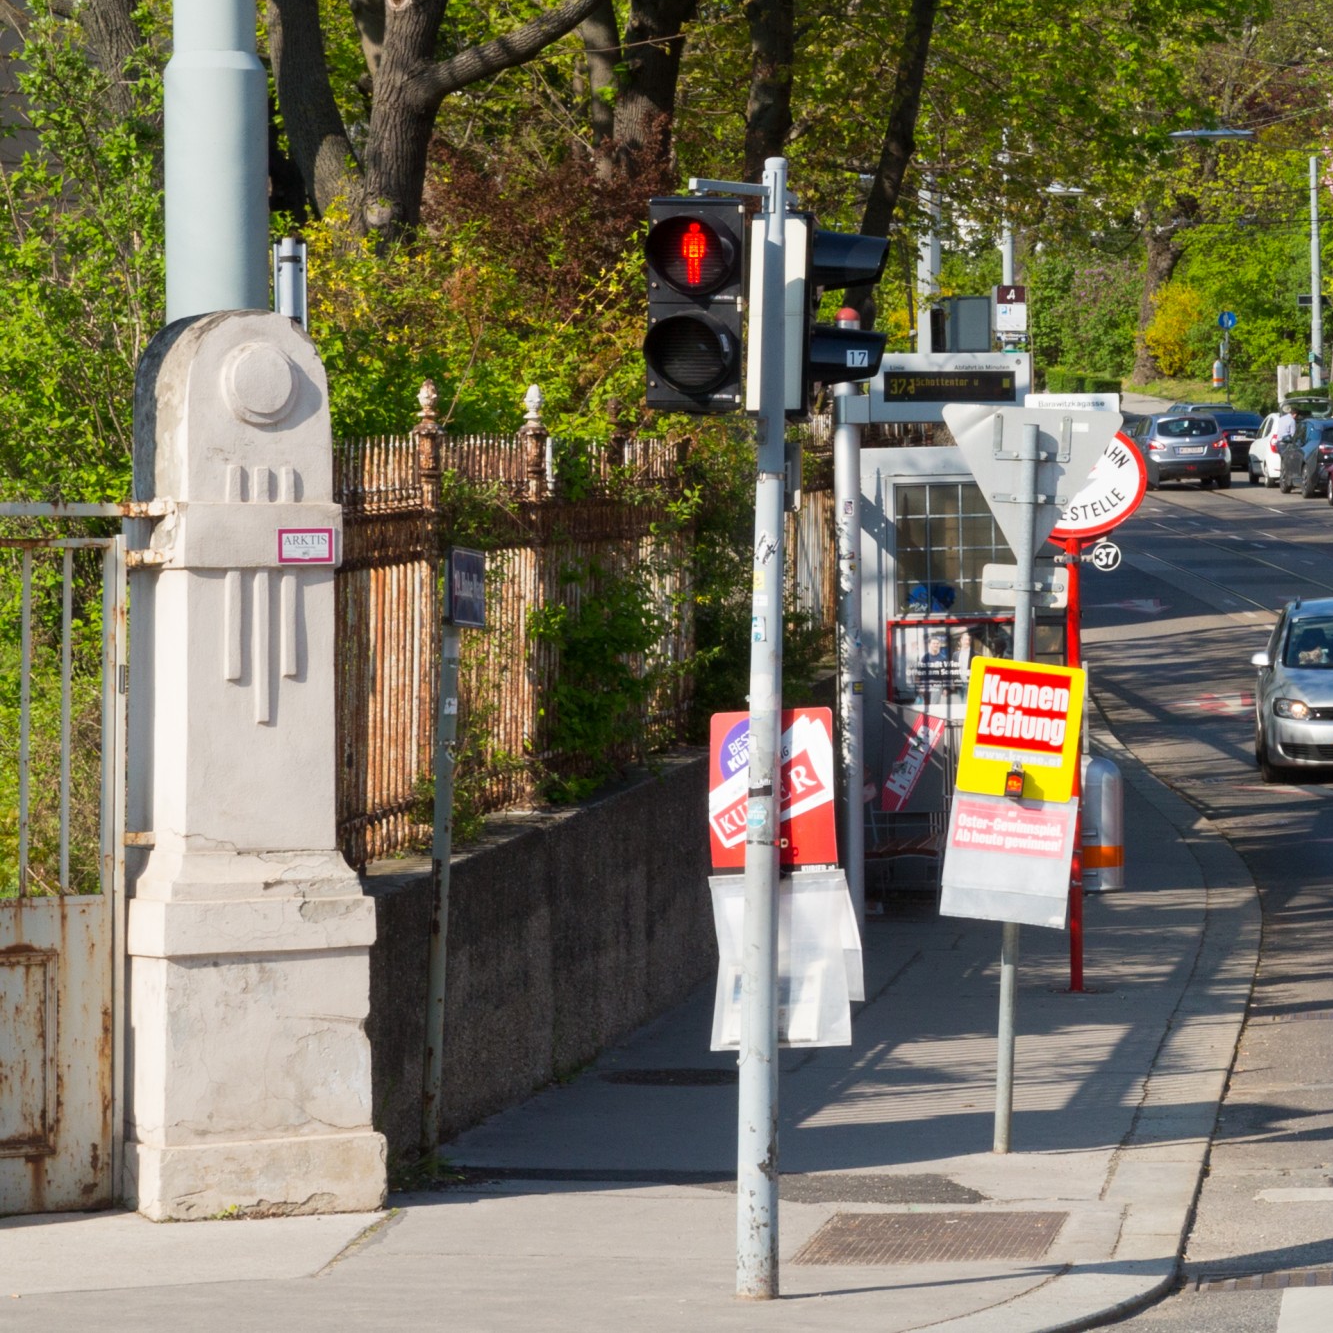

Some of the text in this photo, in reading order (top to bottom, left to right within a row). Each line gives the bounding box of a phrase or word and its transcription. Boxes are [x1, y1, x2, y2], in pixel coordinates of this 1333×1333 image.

[849, 351, 867, 366] 17
[890, 378, 907, 395] 37
[915, 378, 969, 387] Schottentor
[1038, 400, 1106, 409] Barawitzkagasse
[283, 534, 328, 546] ARKTIS
[1095, 548, 1117, 566] 37
[981, 673, 1070, 713] Kronen
[977, 704, 1067, 747] Zeitung
[974, 748, 1062, 767] www.krone.at
[957, 812, 1064, 838] Oster-Gewinnspiel.
[955, 828, 1063, 852] Ab heute gewinnen!
